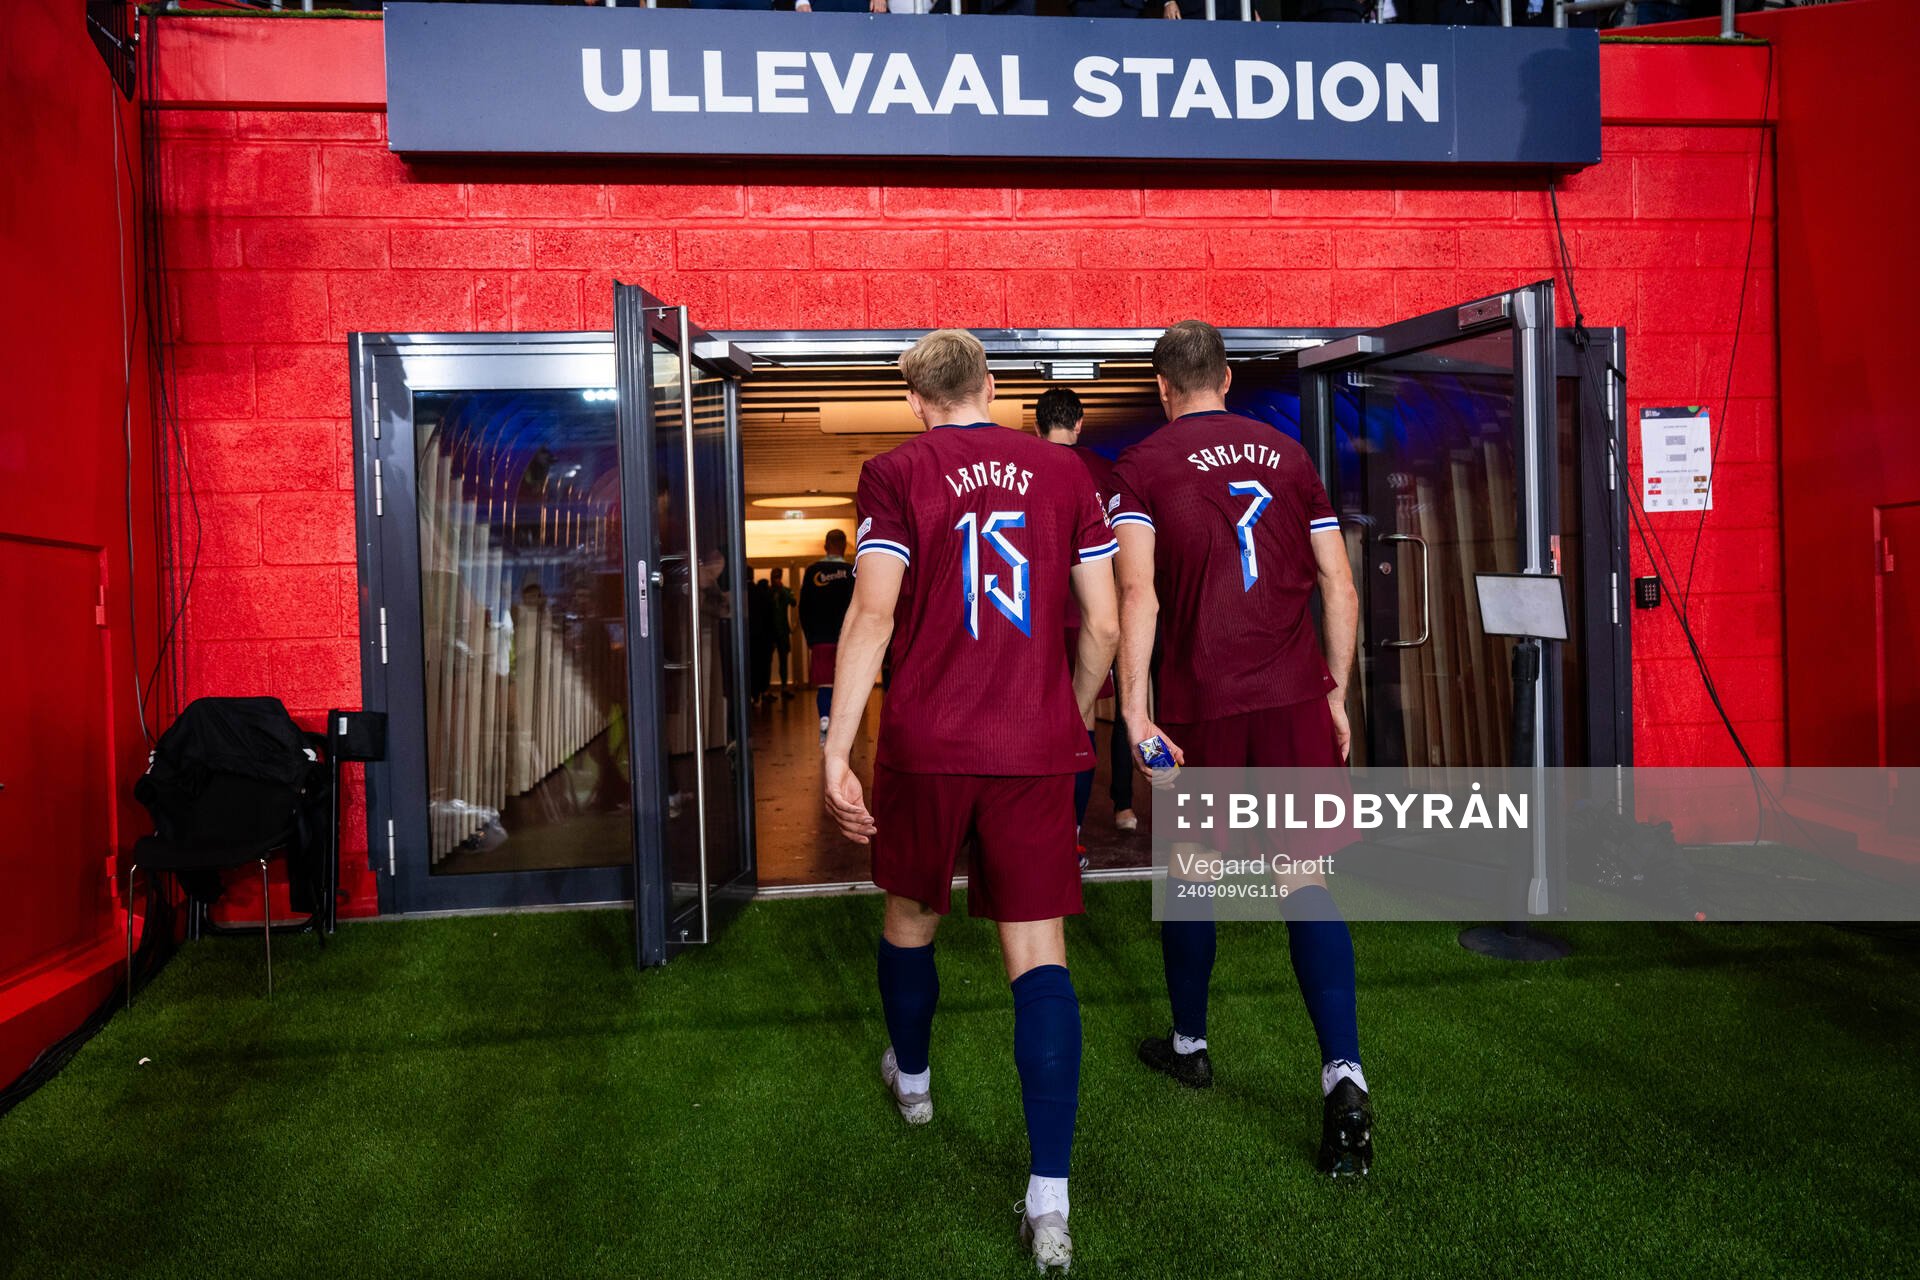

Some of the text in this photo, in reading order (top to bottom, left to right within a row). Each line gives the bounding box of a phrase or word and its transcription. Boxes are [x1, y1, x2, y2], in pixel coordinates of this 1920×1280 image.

[582, 48, 1440, 124] ULLEVAAL STADION
[945, 461, 1034, 498] LANGÅS
[954, 510, 1032, 640] 15
[1228, 480, 1273, 593] 7
